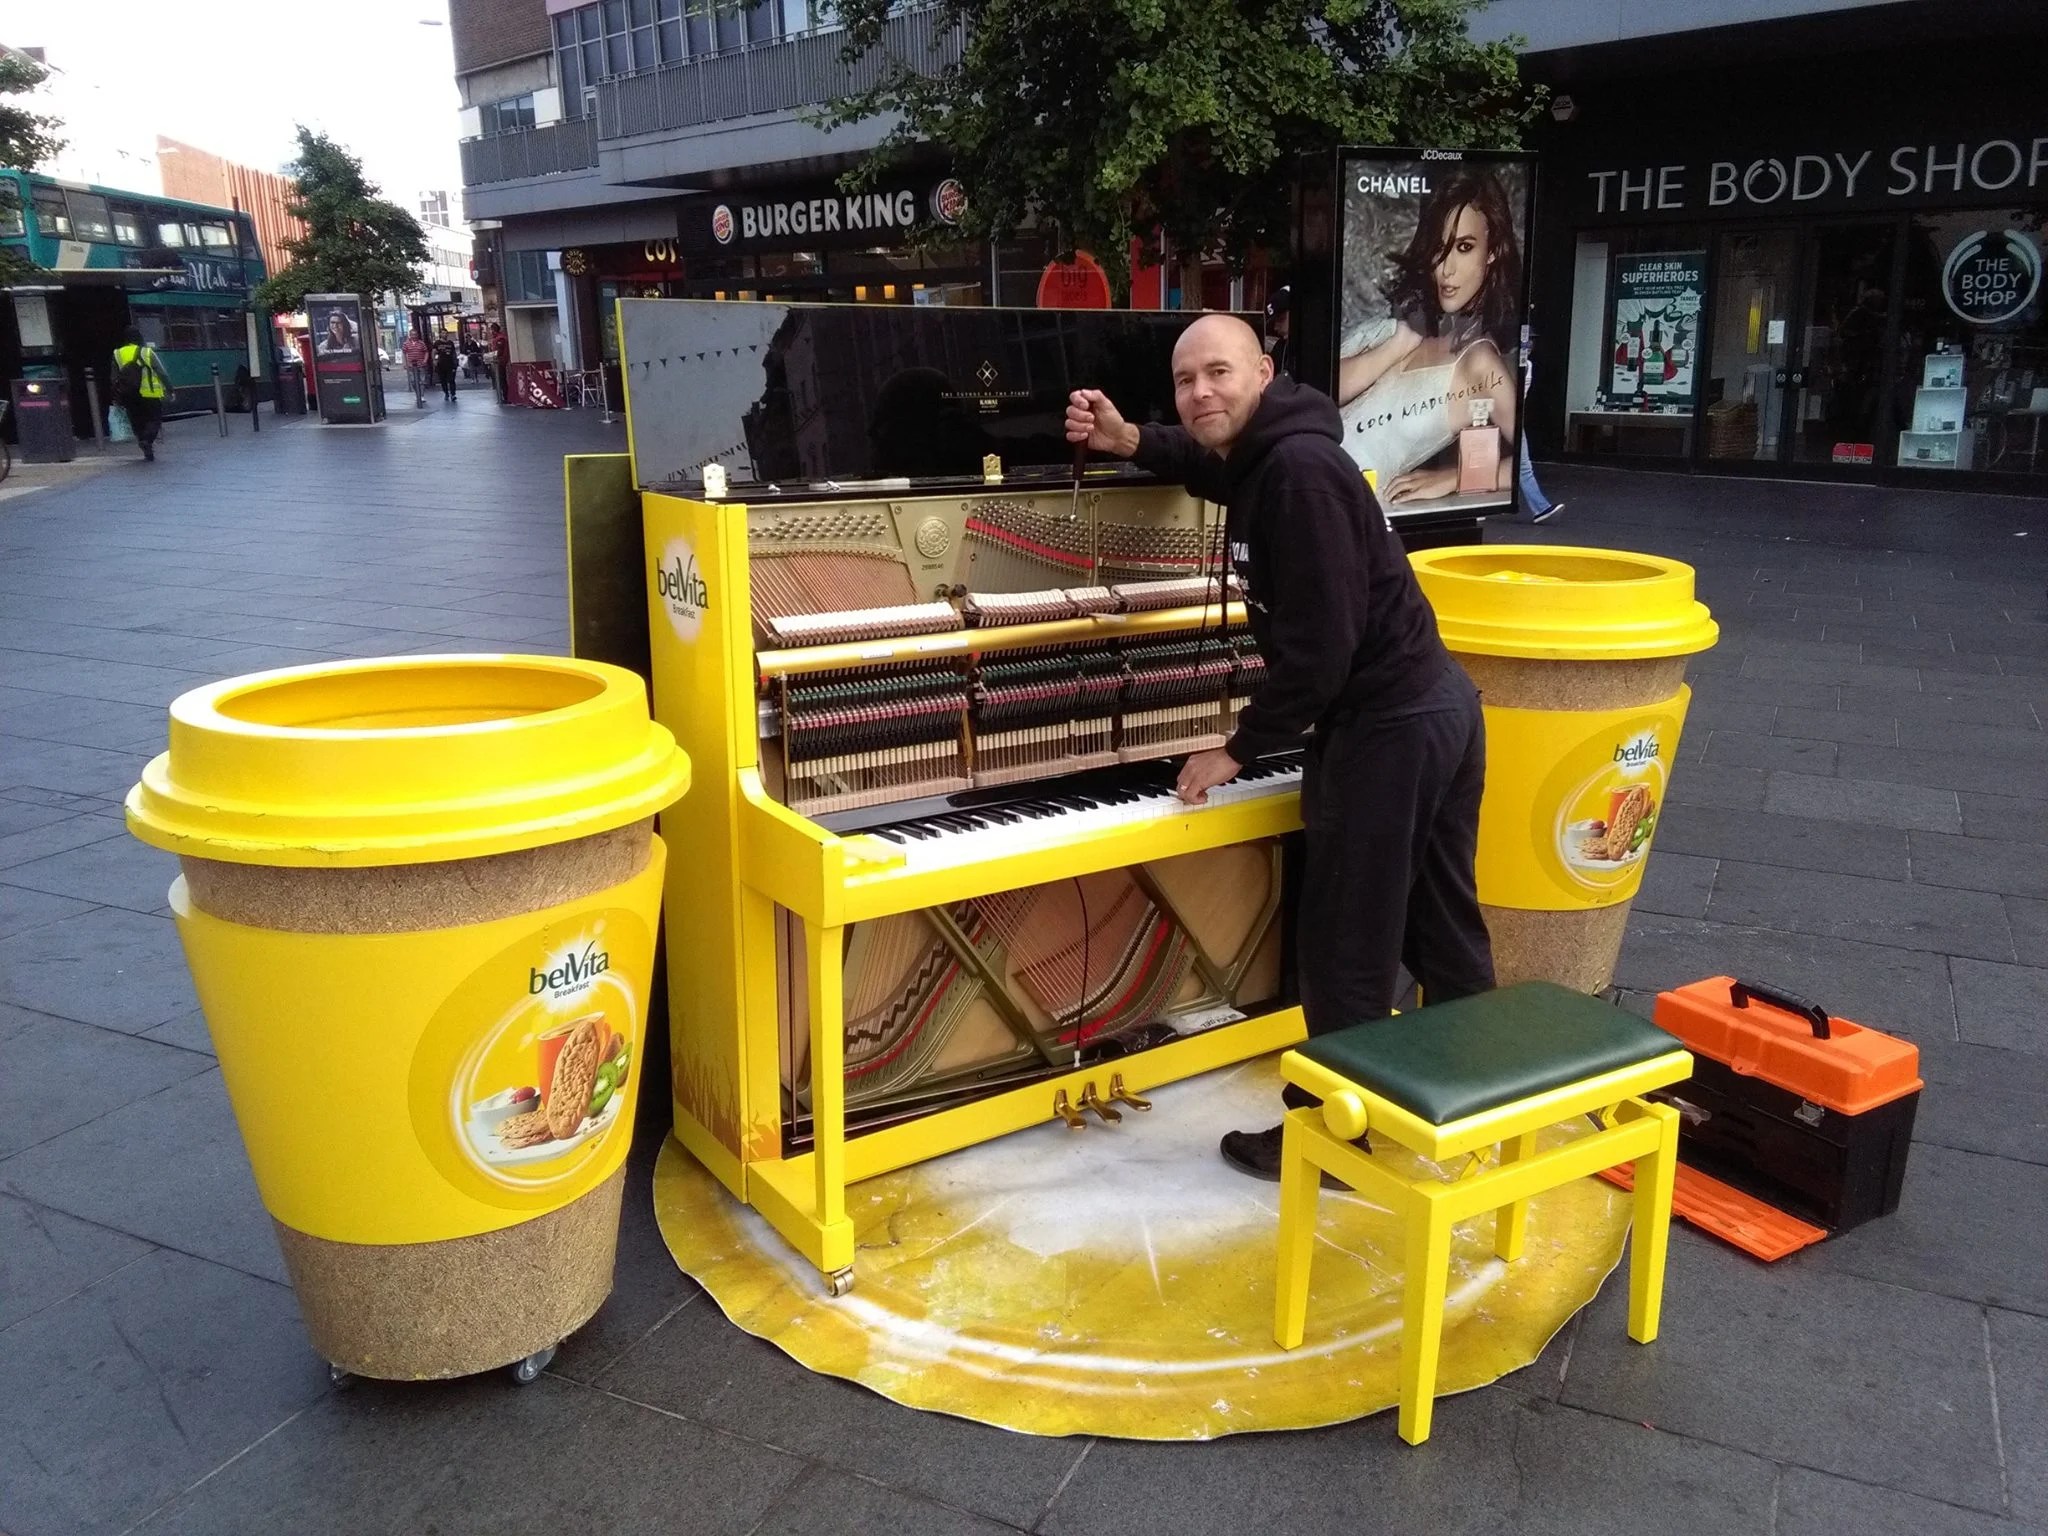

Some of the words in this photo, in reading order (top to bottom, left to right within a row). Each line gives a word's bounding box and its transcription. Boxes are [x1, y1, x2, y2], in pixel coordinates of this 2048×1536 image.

[1420, 149, 1463, 160] JCDecaux
[1357, 176, 1431, 194] CHANEL
[1588, 166, 1686, 213] THE
[1708, 150, 1872, 207] BODY
[741, 197, 841, 239] BURGER
[845, 189, 915, 230] KING
[1638, 263, 1662, 272] CLEAR
[1664, 262, 1683, 271] SKIN
[1975, 258, 2009, 272] THE
[1621, 271, 1699, 284] SUPERHEROES
[1961, 273, 2022, 290] BODY
[1962, 290, 2017, 306] SHOP
[1356, 412, 1393, 434] COCO
[1401, 370, 1504, 420] MADEMOISELLE
[656, 554, 710, 610] belVita
[1613, 734, 1660, 762] belVita
[529, 940, 610, 995] belVita
[554, 980, 590, 999] Breakfast
